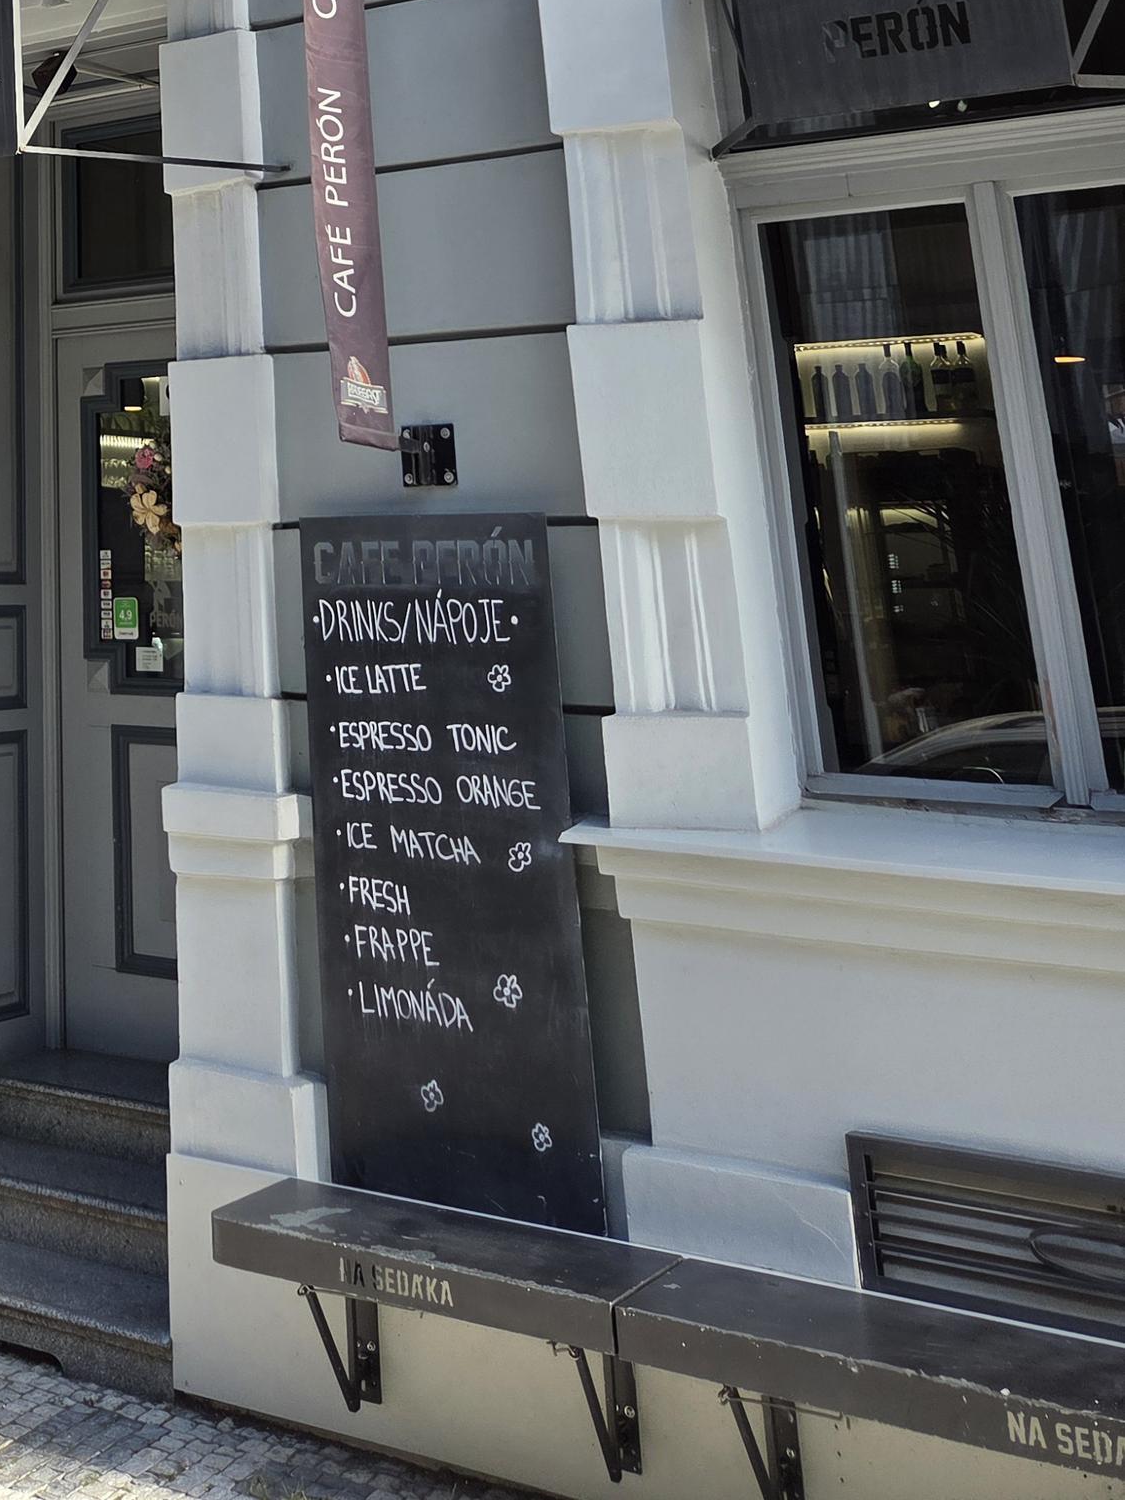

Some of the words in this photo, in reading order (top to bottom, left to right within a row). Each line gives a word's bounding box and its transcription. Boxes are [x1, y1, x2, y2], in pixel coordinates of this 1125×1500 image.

[316, 87, 350, 207] PERÓN
[323, 224, 357, 318] CAFÉ
[313, 538, 401, 585] CAFE
[411, 525, 536, 587] PERÓN
[335, 665, 363, 694] ICE
[365, 663, 427, 693] LATTE
[339, 721, 432, 752] ESPRESSO
[446, 723, 517, 755] TONIC
[340, 769, 443, 804] ESPRESSO
[456, 774, 541, 810] ORANGE
[346, 822, 378, 850] ICE
[390, 825, 481, 865] MATCHA
[348, 876, 411, 915] FRESH
[355, 924, 440, 966] FRAPPE
[359, 978, 474, 1032] LIMONÁDA
[372, 1264, 454, 1308] SEDAKA
[1006, 1410, 1048, 1450] NA
